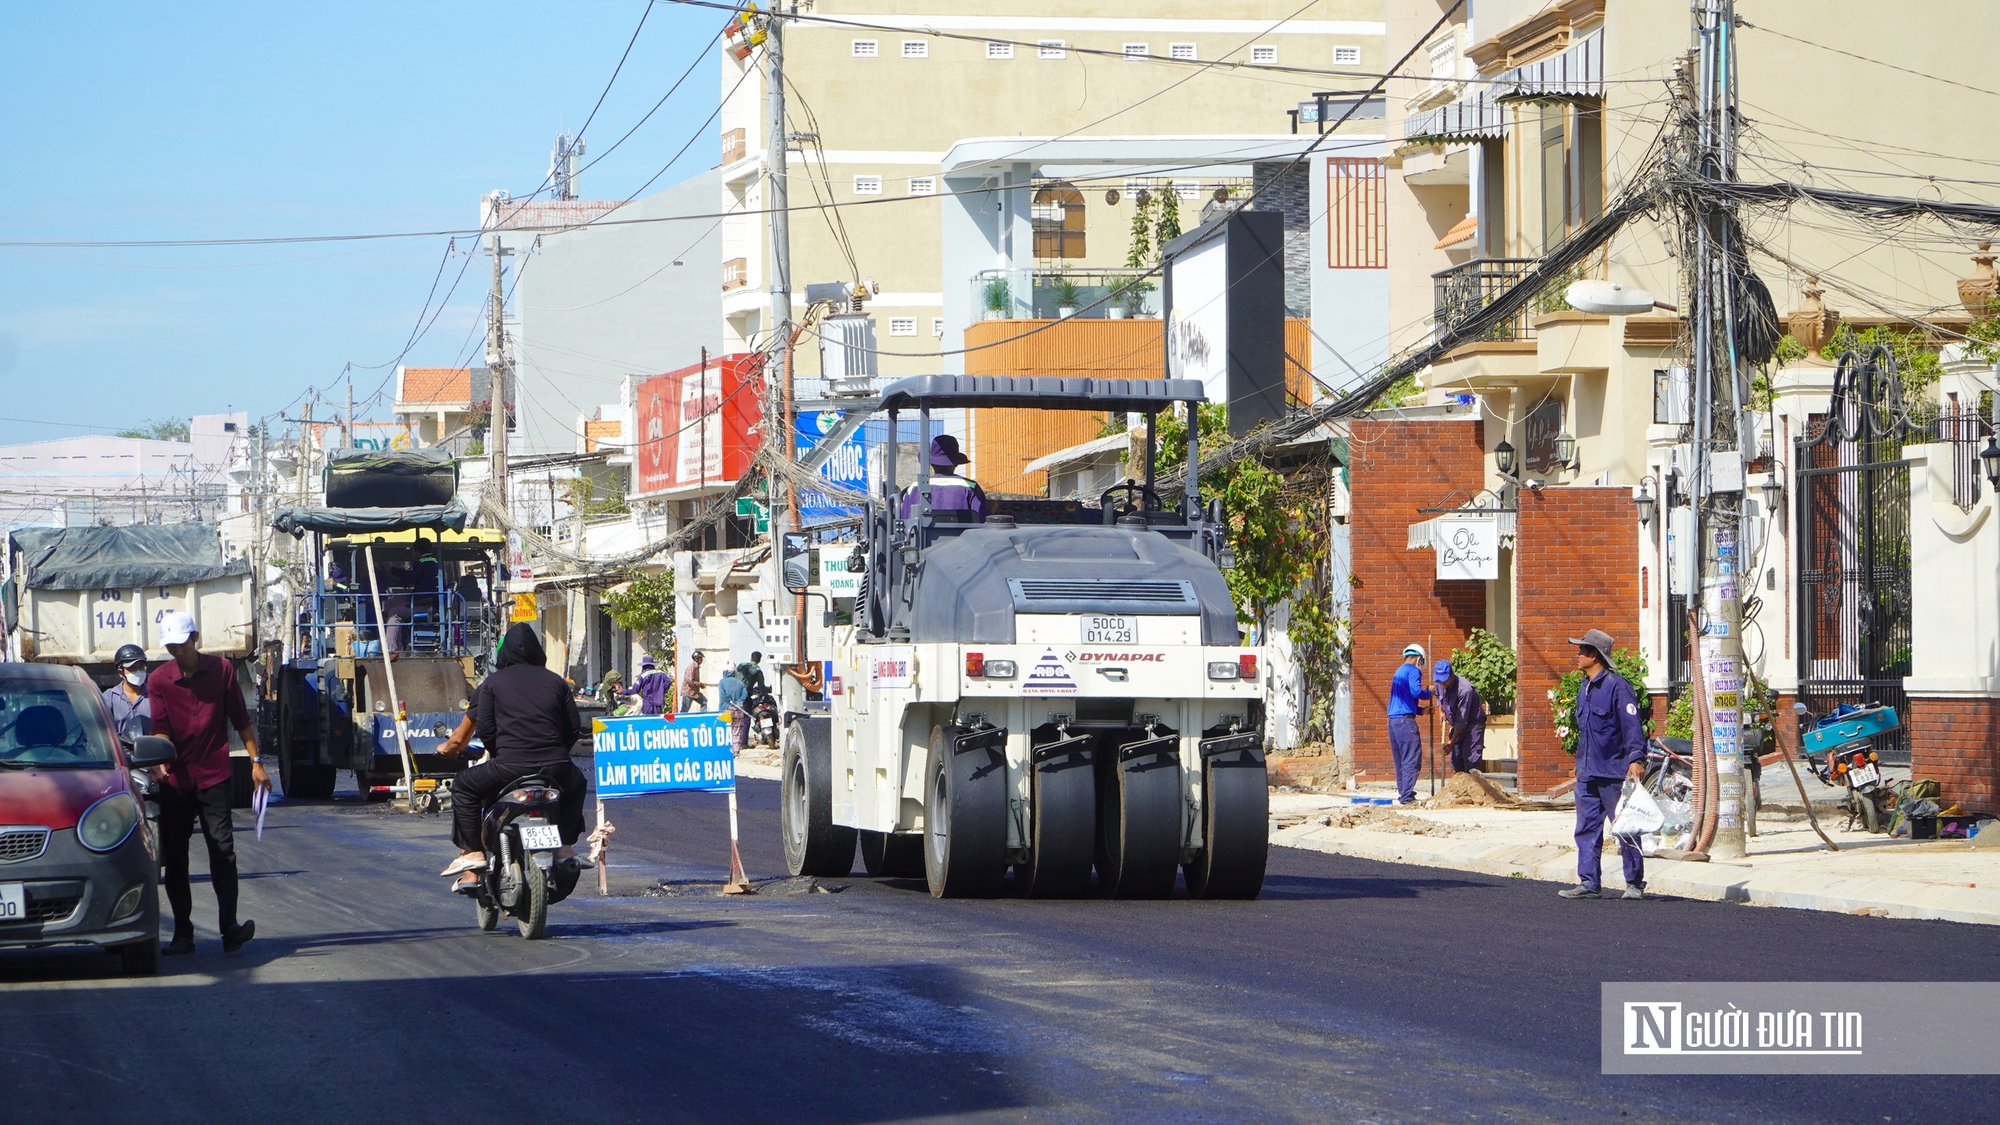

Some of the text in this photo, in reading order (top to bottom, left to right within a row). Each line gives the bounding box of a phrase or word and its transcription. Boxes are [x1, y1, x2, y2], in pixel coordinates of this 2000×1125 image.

[1452, 527, 1480, 550] Oli
[1442, 548, 1493, 568] Boutique
[96, 611, 126, 629] 144
[1092, 617, 1125, 630] 50CD
[1087, 630, 1131, 643] 014.29
[1079, 653, 1166, 662] DYNAPAC
[1036, 666, 1065, 677] RDG
[593, 723, 733, 752] XIN LỖI CHÚNG TÔI ĐÃ
[598, 757, 732, 786] LÀM PHIỀN CÁC BẠN
[525, 827, 553, 838] 86-C1
[525, 837, 560, 849] 734.35
